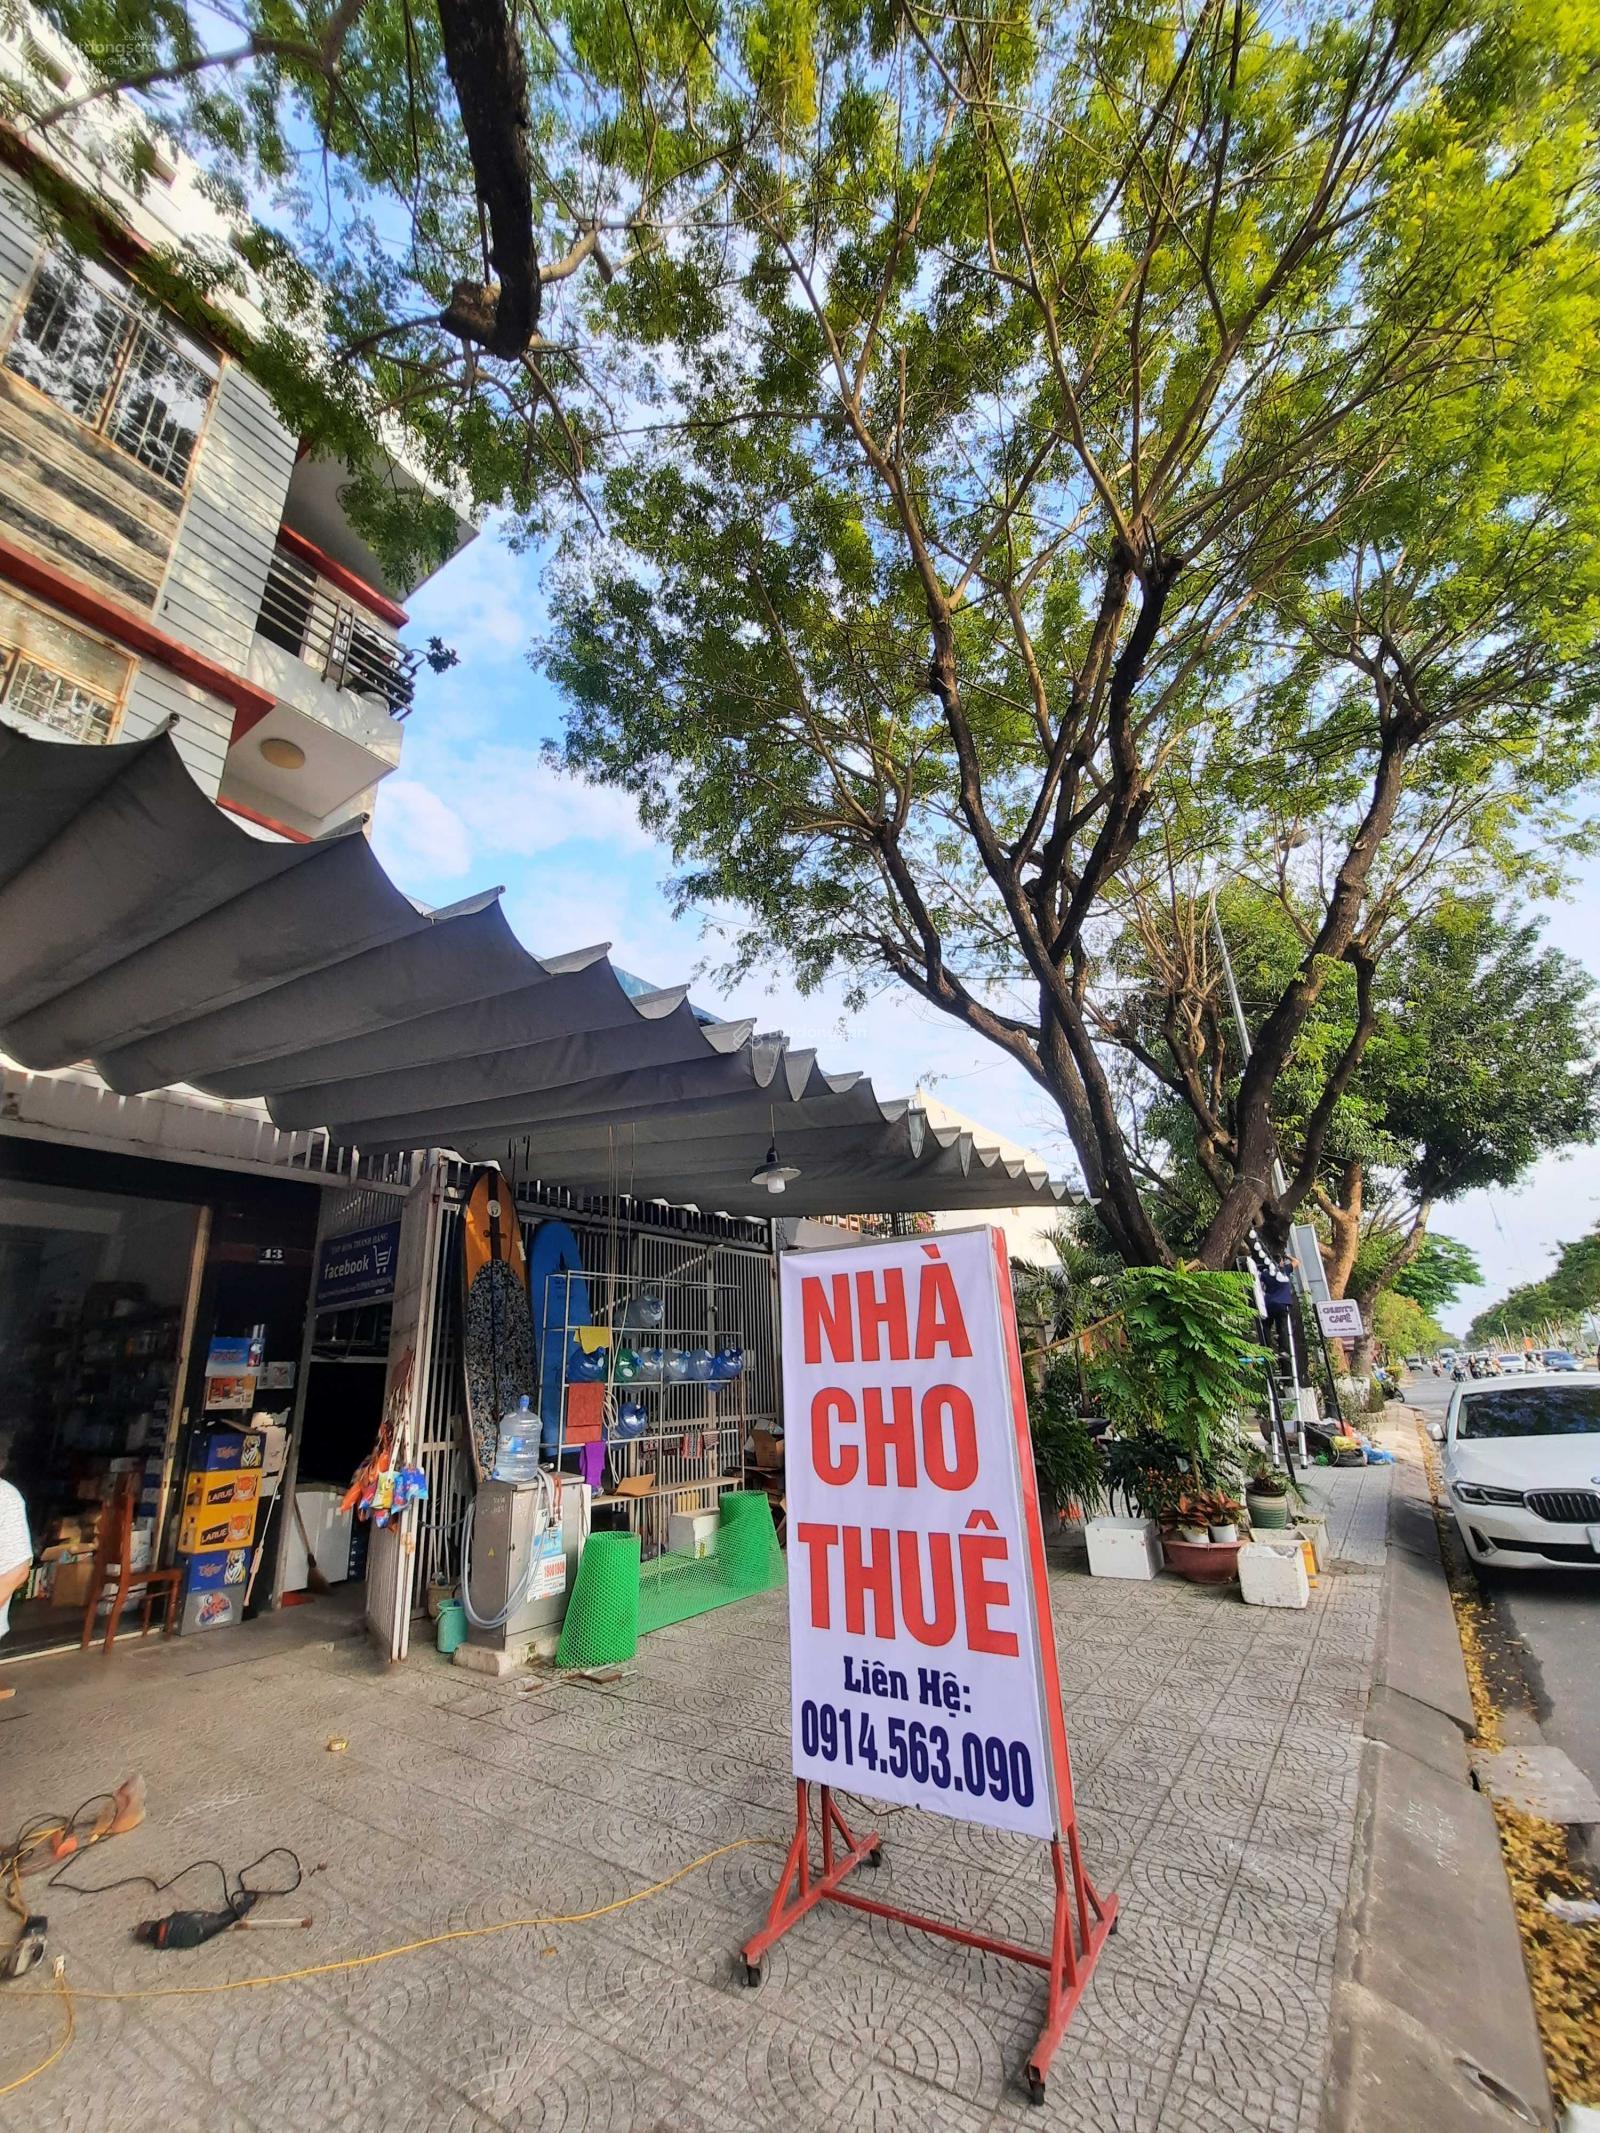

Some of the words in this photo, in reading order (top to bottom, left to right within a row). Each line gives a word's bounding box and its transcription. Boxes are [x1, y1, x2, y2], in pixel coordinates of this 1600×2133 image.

[324, 1254, 369, 1280] facebook
[801, 1243, 973, 1364] NHÀ
[811, 1383, 979, 1491] CHO
[201, 1528, 228, 1543] LARUE
[208, 1487, 234, 1502] LARUE
[797, 1509, 1020, 1658] THUÊ
[843, 1656, 909, 1701] Liên
[918, 1667, 972, 1717] Hệ:
[801, 1700, 1034, 1807] 0914.563.090
